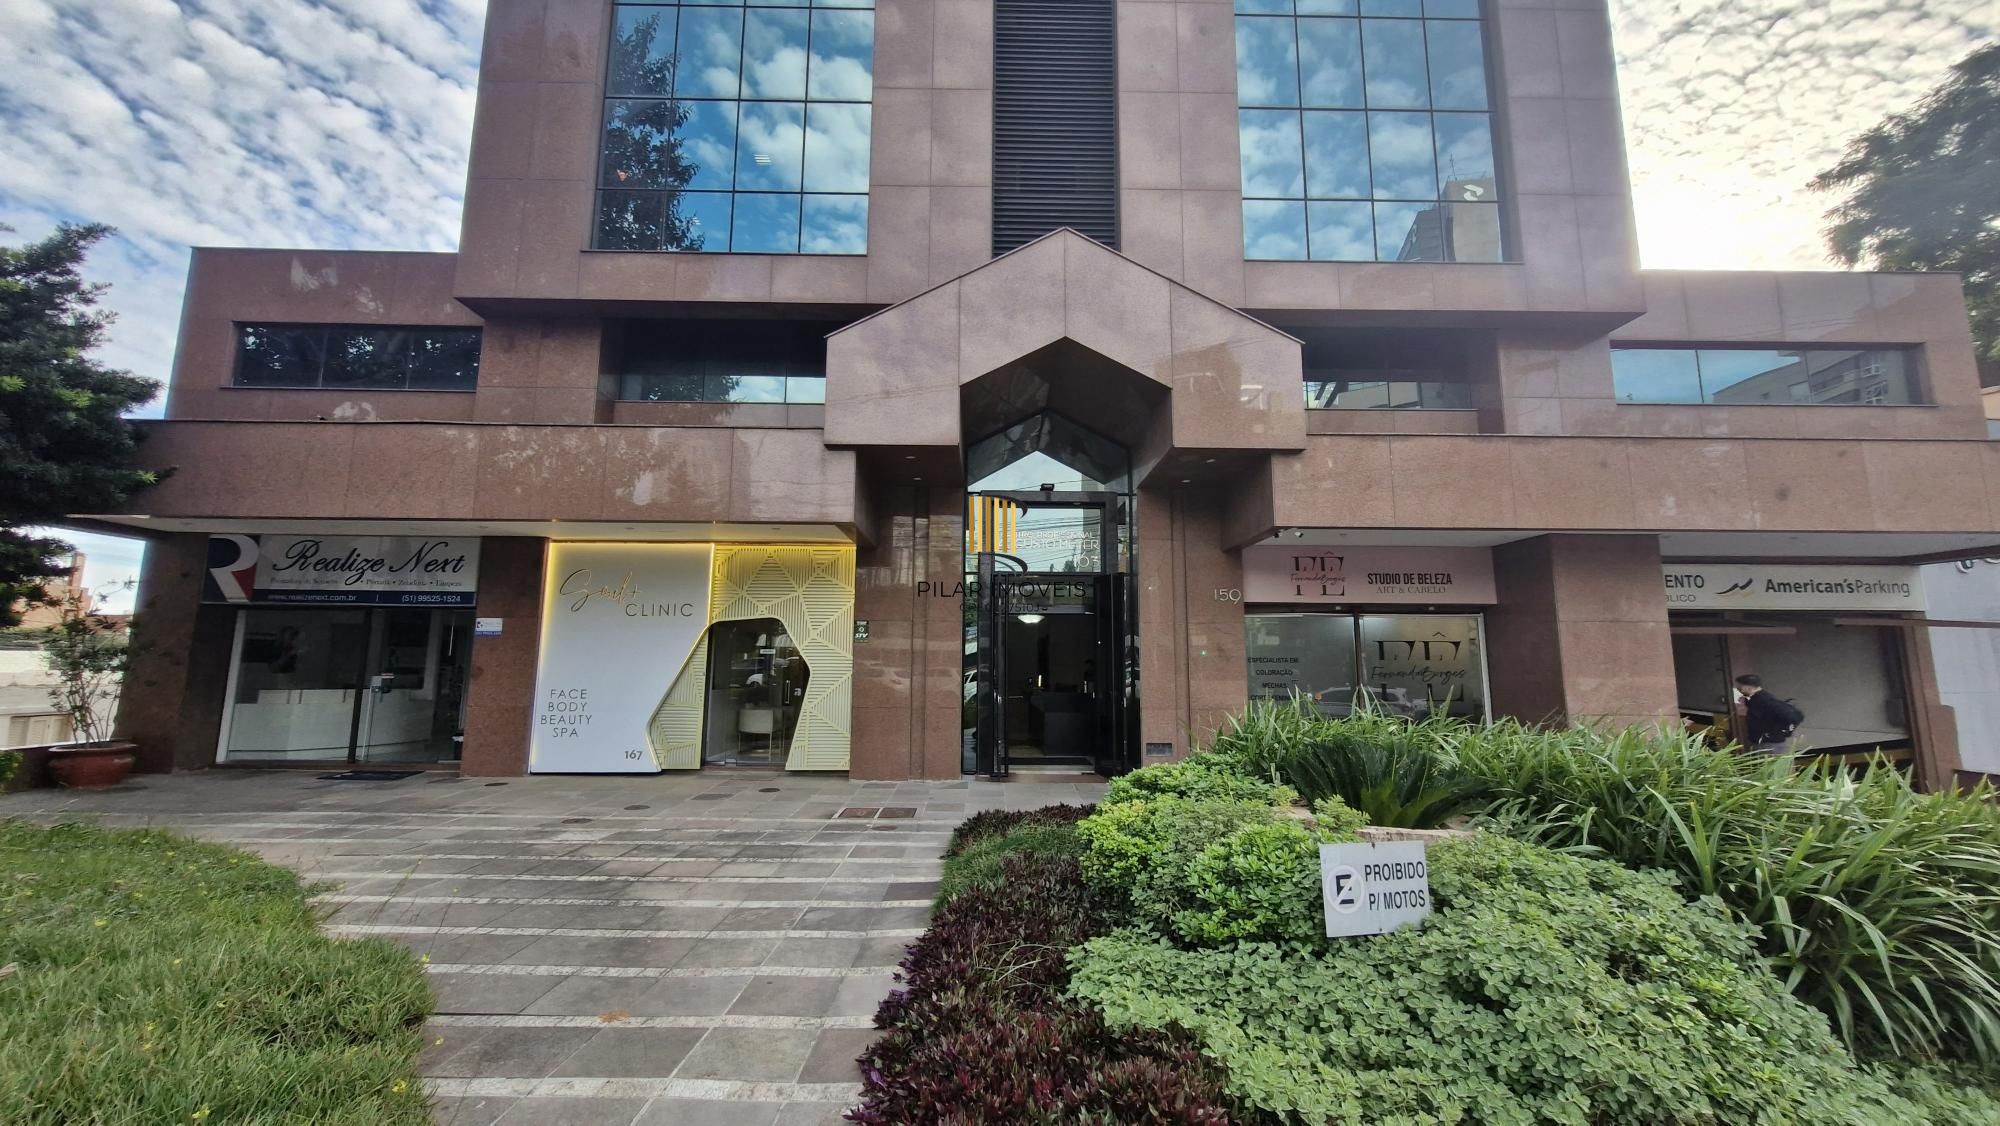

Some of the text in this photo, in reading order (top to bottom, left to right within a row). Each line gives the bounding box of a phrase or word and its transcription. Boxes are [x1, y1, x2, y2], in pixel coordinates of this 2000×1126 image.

[272, 540, 465, 586] Realize Next
[1367, 573, 1453, 585] STUDIO DE BELEZA
[1664, 574, 1705, 588] ENTO
[1376, 586, 1446, 594] ART & CABELO
[401, 594, 461, 603] (51) 99525-1524
[1214, 588, 1242, 605] 159
[625, 603, 694, 617] CLINIC
[550, 689, 588, 700] FACE
[548, 702, 588, 712] BODY
[541, 714, 593, 725] BEAUTY
[553, 728, 579, 738] SPA
[625, 749, 643, 761] 167
[1364, 861, 1425, 882] PROIBIDO
[1369, 889, 1426, 911] P/ MOTOS
